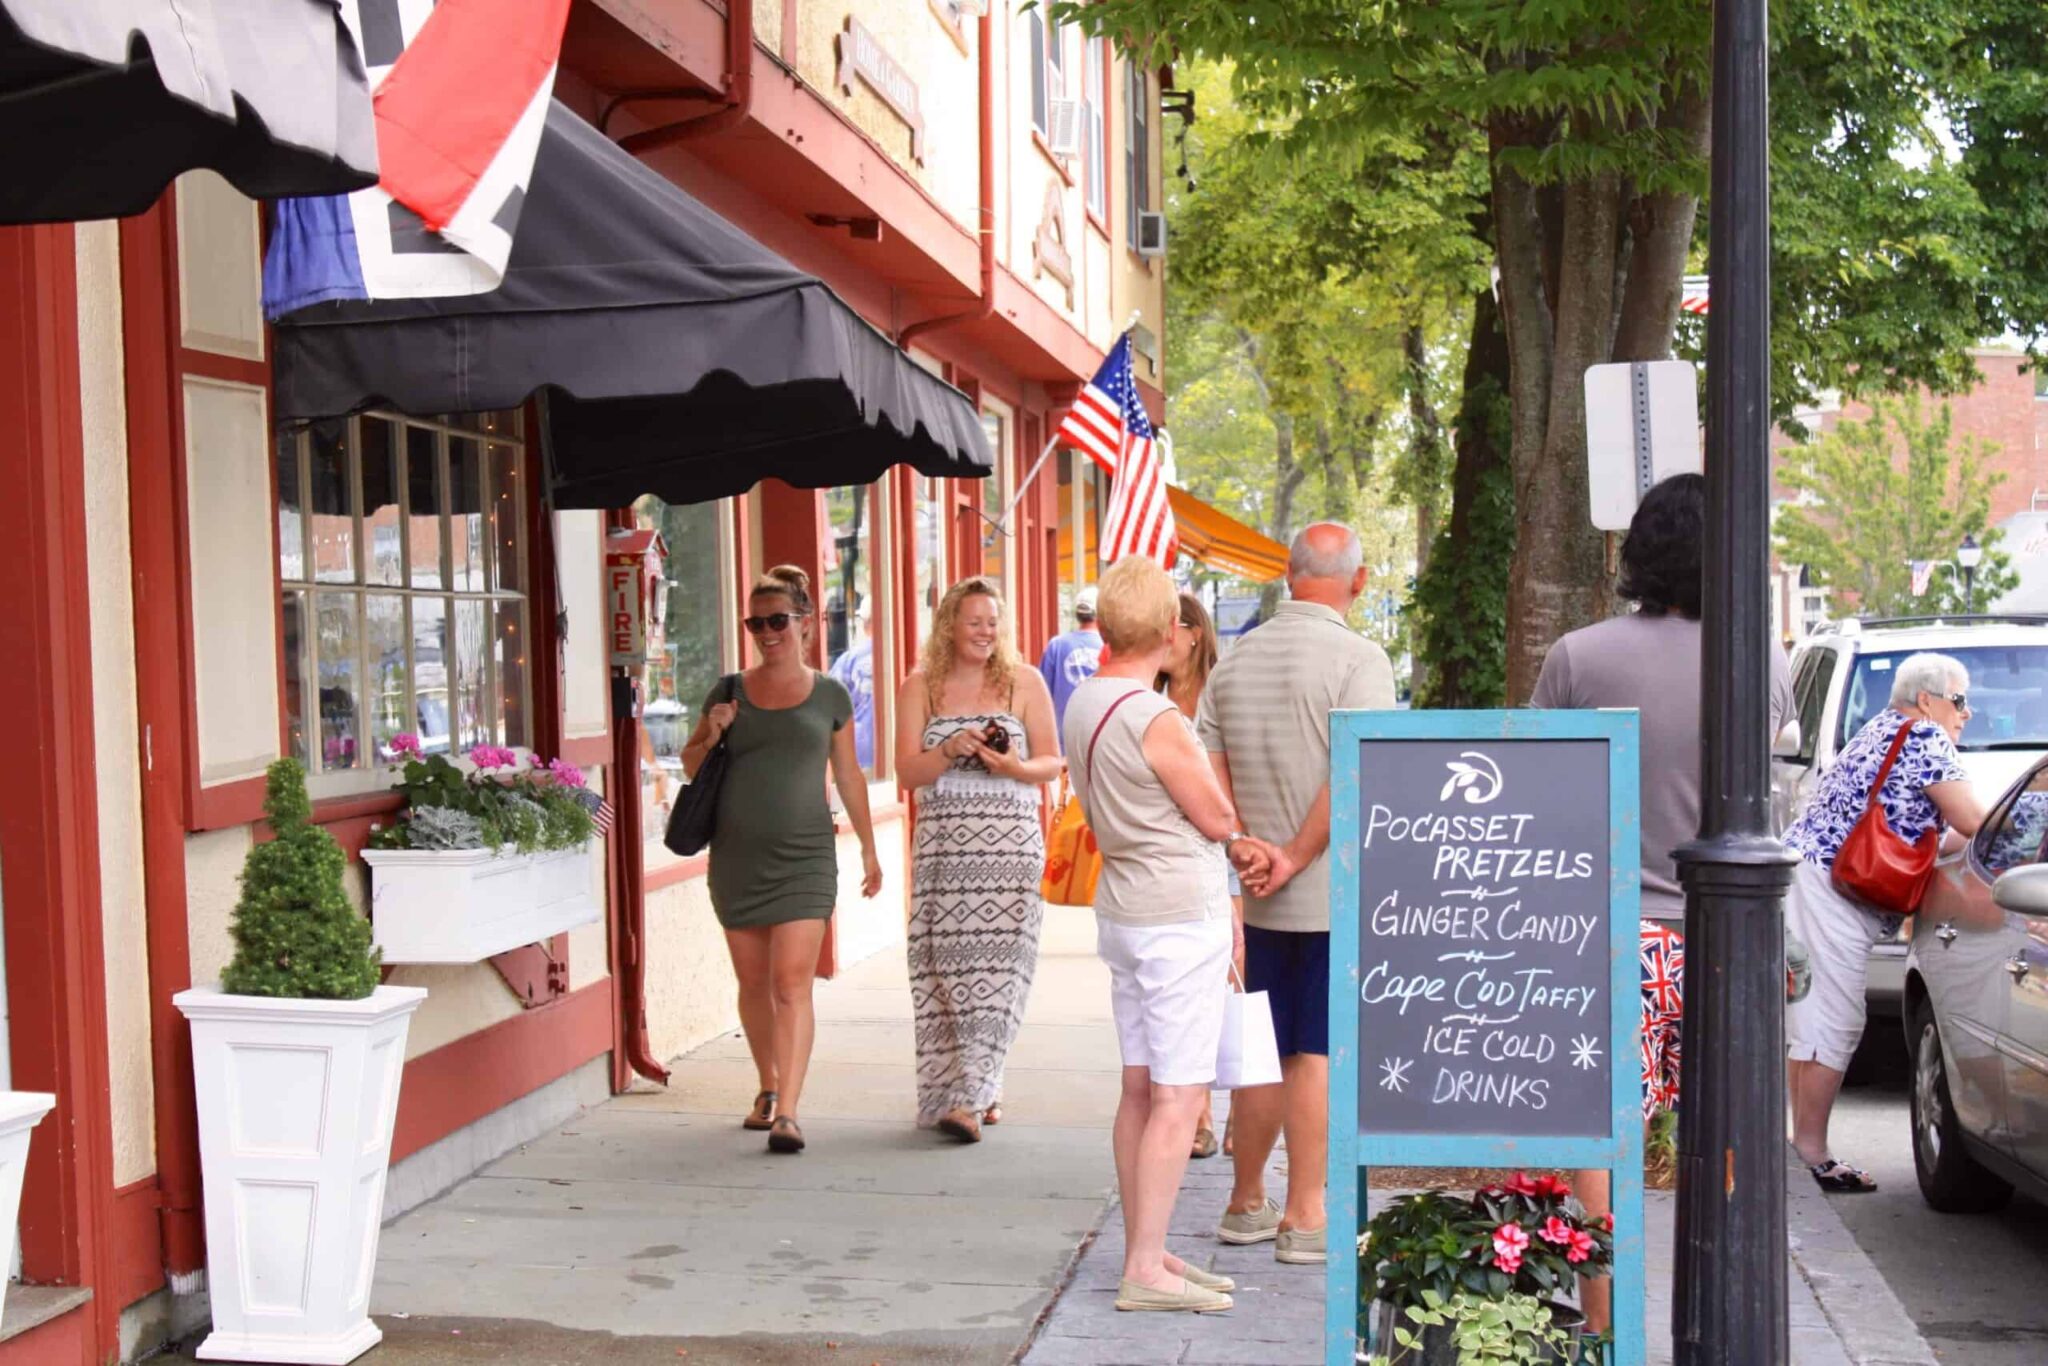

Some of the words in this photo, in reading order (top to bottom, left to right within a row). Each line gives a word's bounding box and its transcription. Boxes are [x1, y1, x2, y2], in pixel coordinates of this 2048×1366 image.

[612, 571, 632, 653] FIRE
[1363, 804, 1535, 848] POCASSET
[1432, 845, 1594, 883] PRETZELS
[1371, 890, 1490, 942] GINGER
[1497, 900, 1599, 956] CANDY
[1361, 960, 1445, 1015] Cape
[1514, 967, 1597, 1015] TAFFY
[1422, 1025, 1477, 1056] ICE
[1483, 1028, 1556, 1064] COLD
[1432, 1067, 1551, 1111] DRINKS
